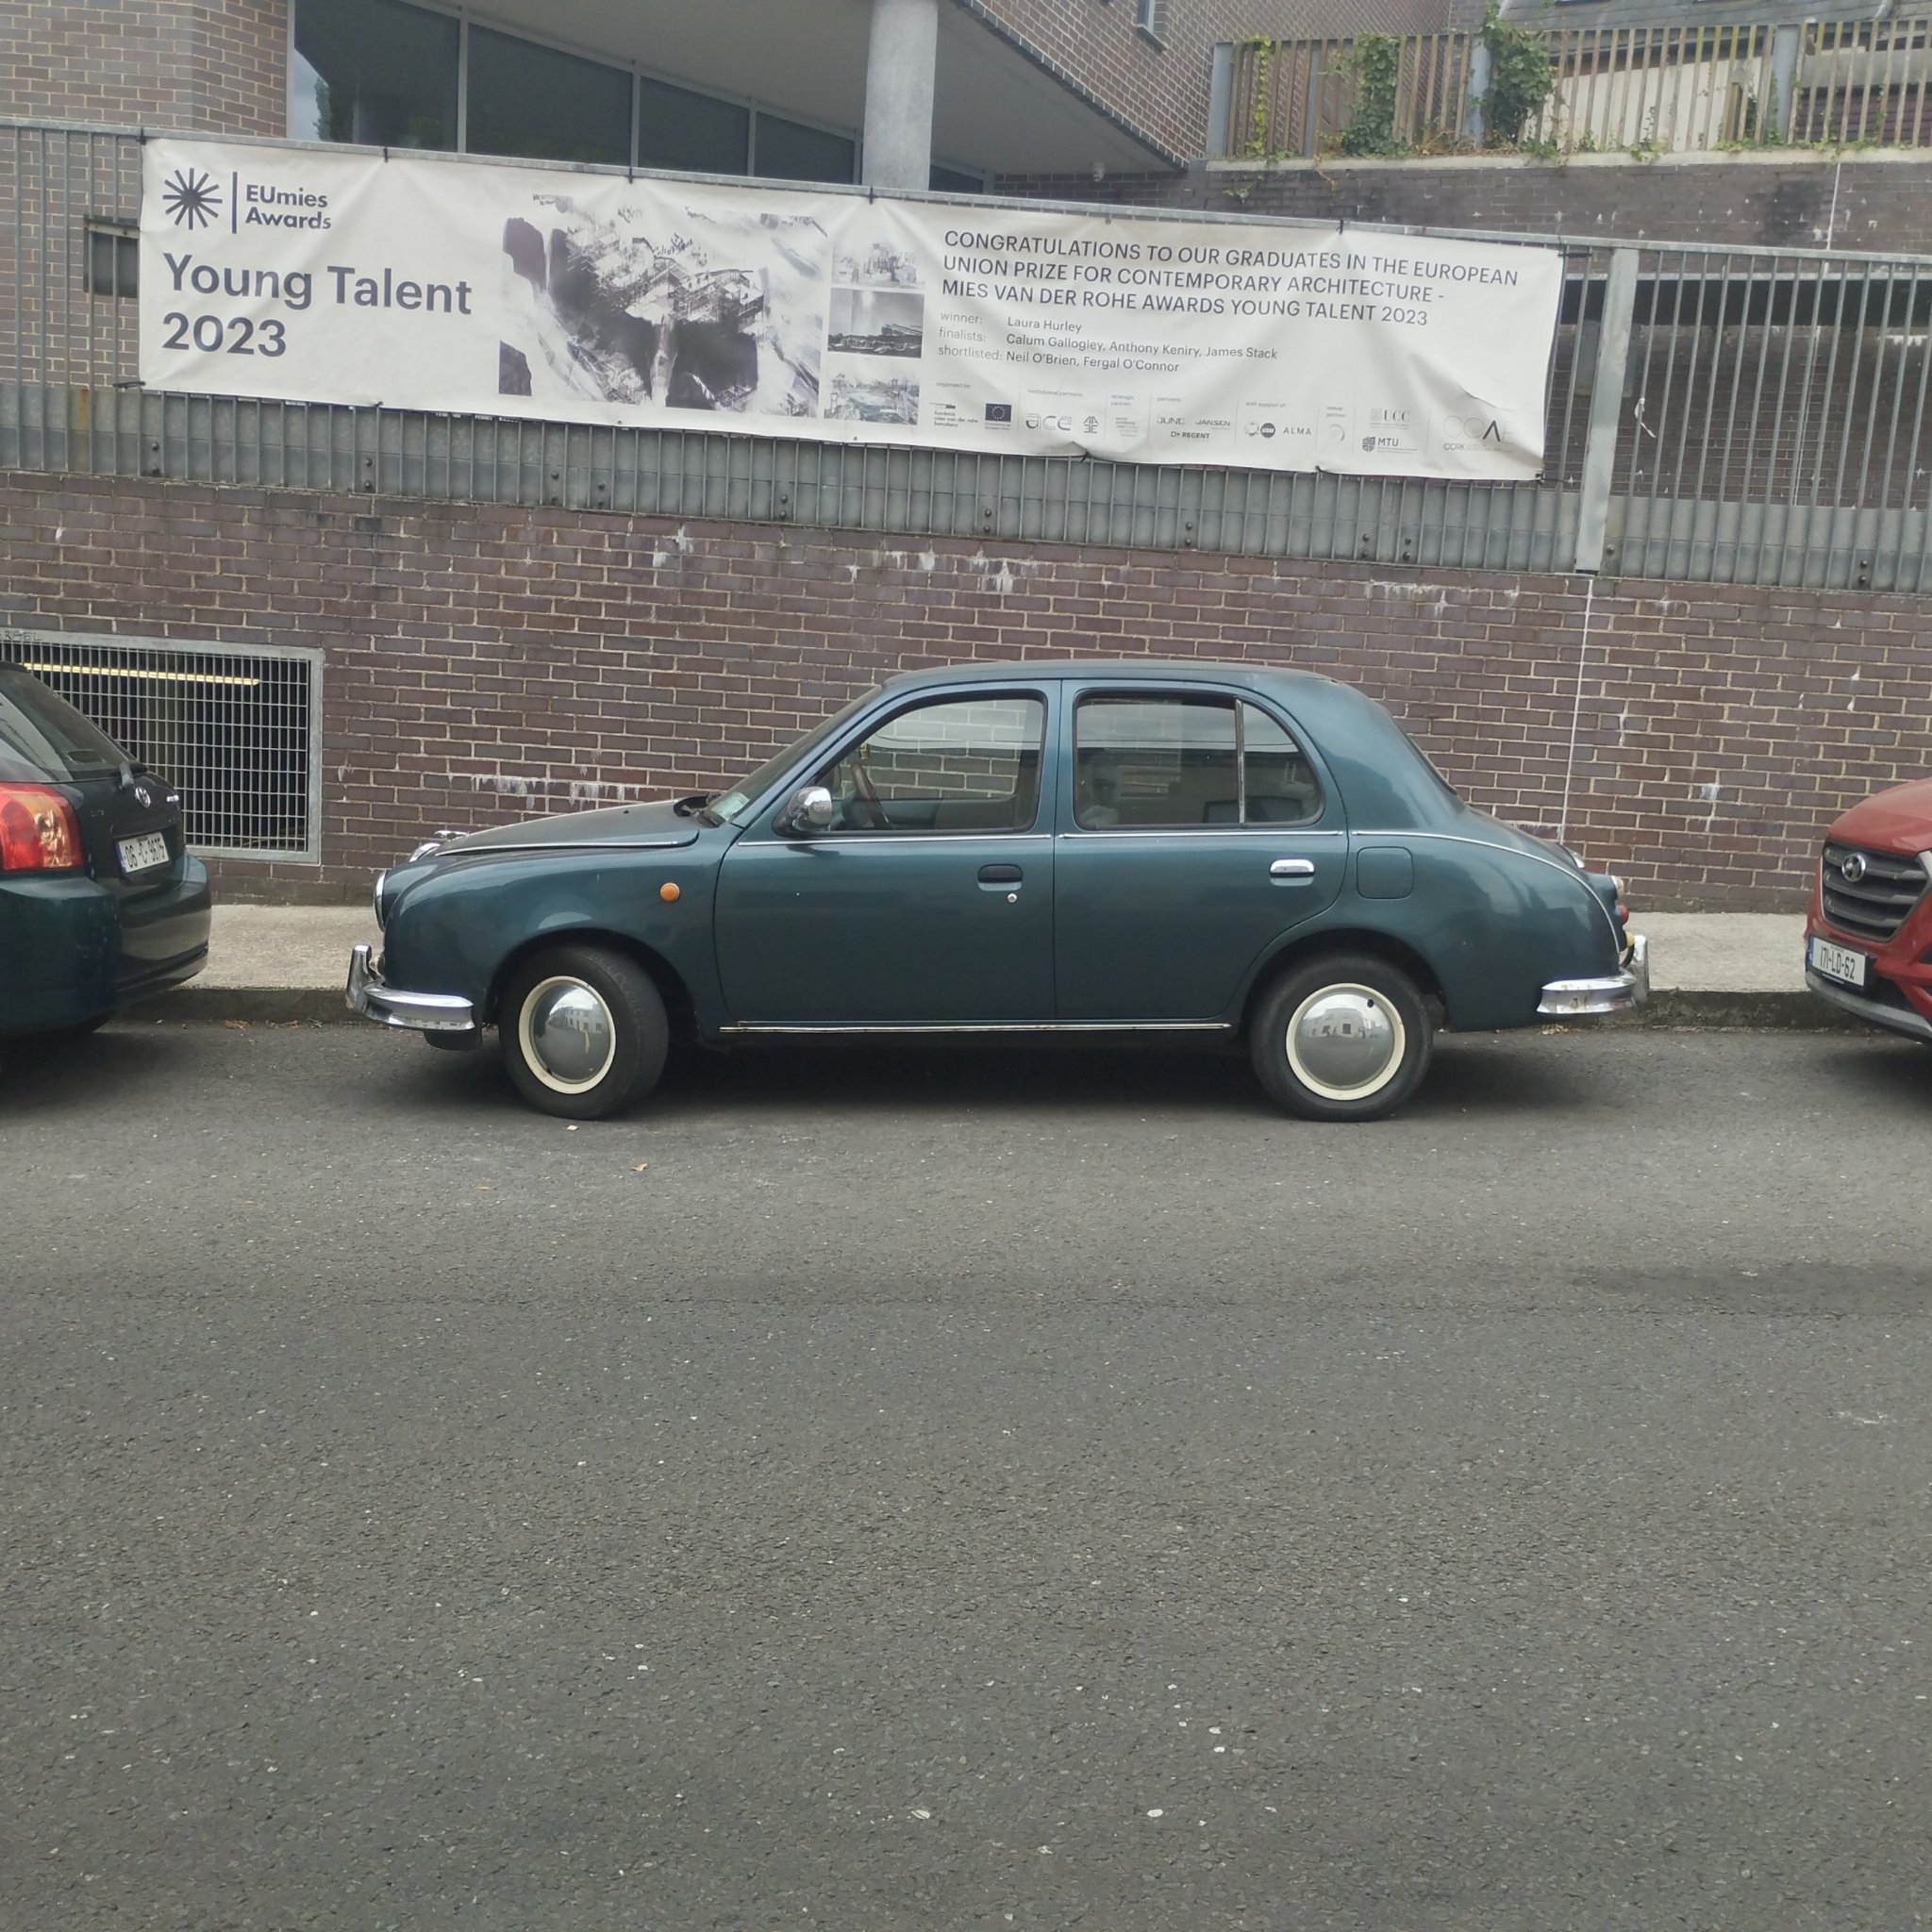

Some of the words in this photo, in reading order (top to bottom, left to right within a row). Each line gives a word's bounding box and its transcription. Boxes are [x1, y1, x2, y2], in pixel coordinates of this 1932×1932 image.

[245, 184, 328, 208] EUmies
[244, 207, 331, 229] Awards
[944, 230, 1141, 259] CONGRATULATIONS
[1146, 245, 1173, 261] TO
[1178, 247, 1220, 264] OUR
[1225, 249, 1341, 270] GRADUATES
[1347, 254, 1366, 270] IN
[1373, 257, 1407, 275] THE
[1413, 261, 1518, 286] EUROPEAN
[162, 252, 312, 310] Young
[326, 265, 472, 315] Talent
[943, 258, 1008, 276] UNION
[1014, 261, 1068, 280] PRIZE
[1074, 266, 1111, 283] FOR
[1117, 268, 1281, 291] CONTEMPORARY
[1287, 277, 1433, 303] ARCHITECTURE
[942, 279, 988, 298] MIES
[994, 285, 1033, 303] VAN
[1040, 288, 1076, 306] DER
[1082, 291, 1137, 309] ROHE
[1141, 294, 1224, 314] AWARDS
[1230, 300, 1300, 317] YOUNG
[1306, 302, 1376, 321] TALENT
[1381, 307, 1427, 325] 2023
[161, 312, 287, 358] 2023
[941, 311, 983, 325] winner:
[1008, 316, 1040, 329] Laura
[1043, 320, 1082, 334] Hurley
[938, 344, 1003, 361] shortlisted:
[1007, 351, 1029, 363] Neil
[1083, 356, 1120, 372] Fergal
[1007, 333, 1044, 346] Calum
[1048, 336, 1107, 353] Gallogley,
[1109, 341, 1158, 356] Anthony
[1162, 344, 1203, 358] Keniry,
[1206, 346, 1243, 358] James
[1246, 347, 1277, 359] Stack
[1383, 409, 1410, 423] UCC
[1283, 426, 1312, 436] ALMA
[1377, 438, 1400, 447] MTU
[1820, 945, 1856, 980] 171-LD-62
